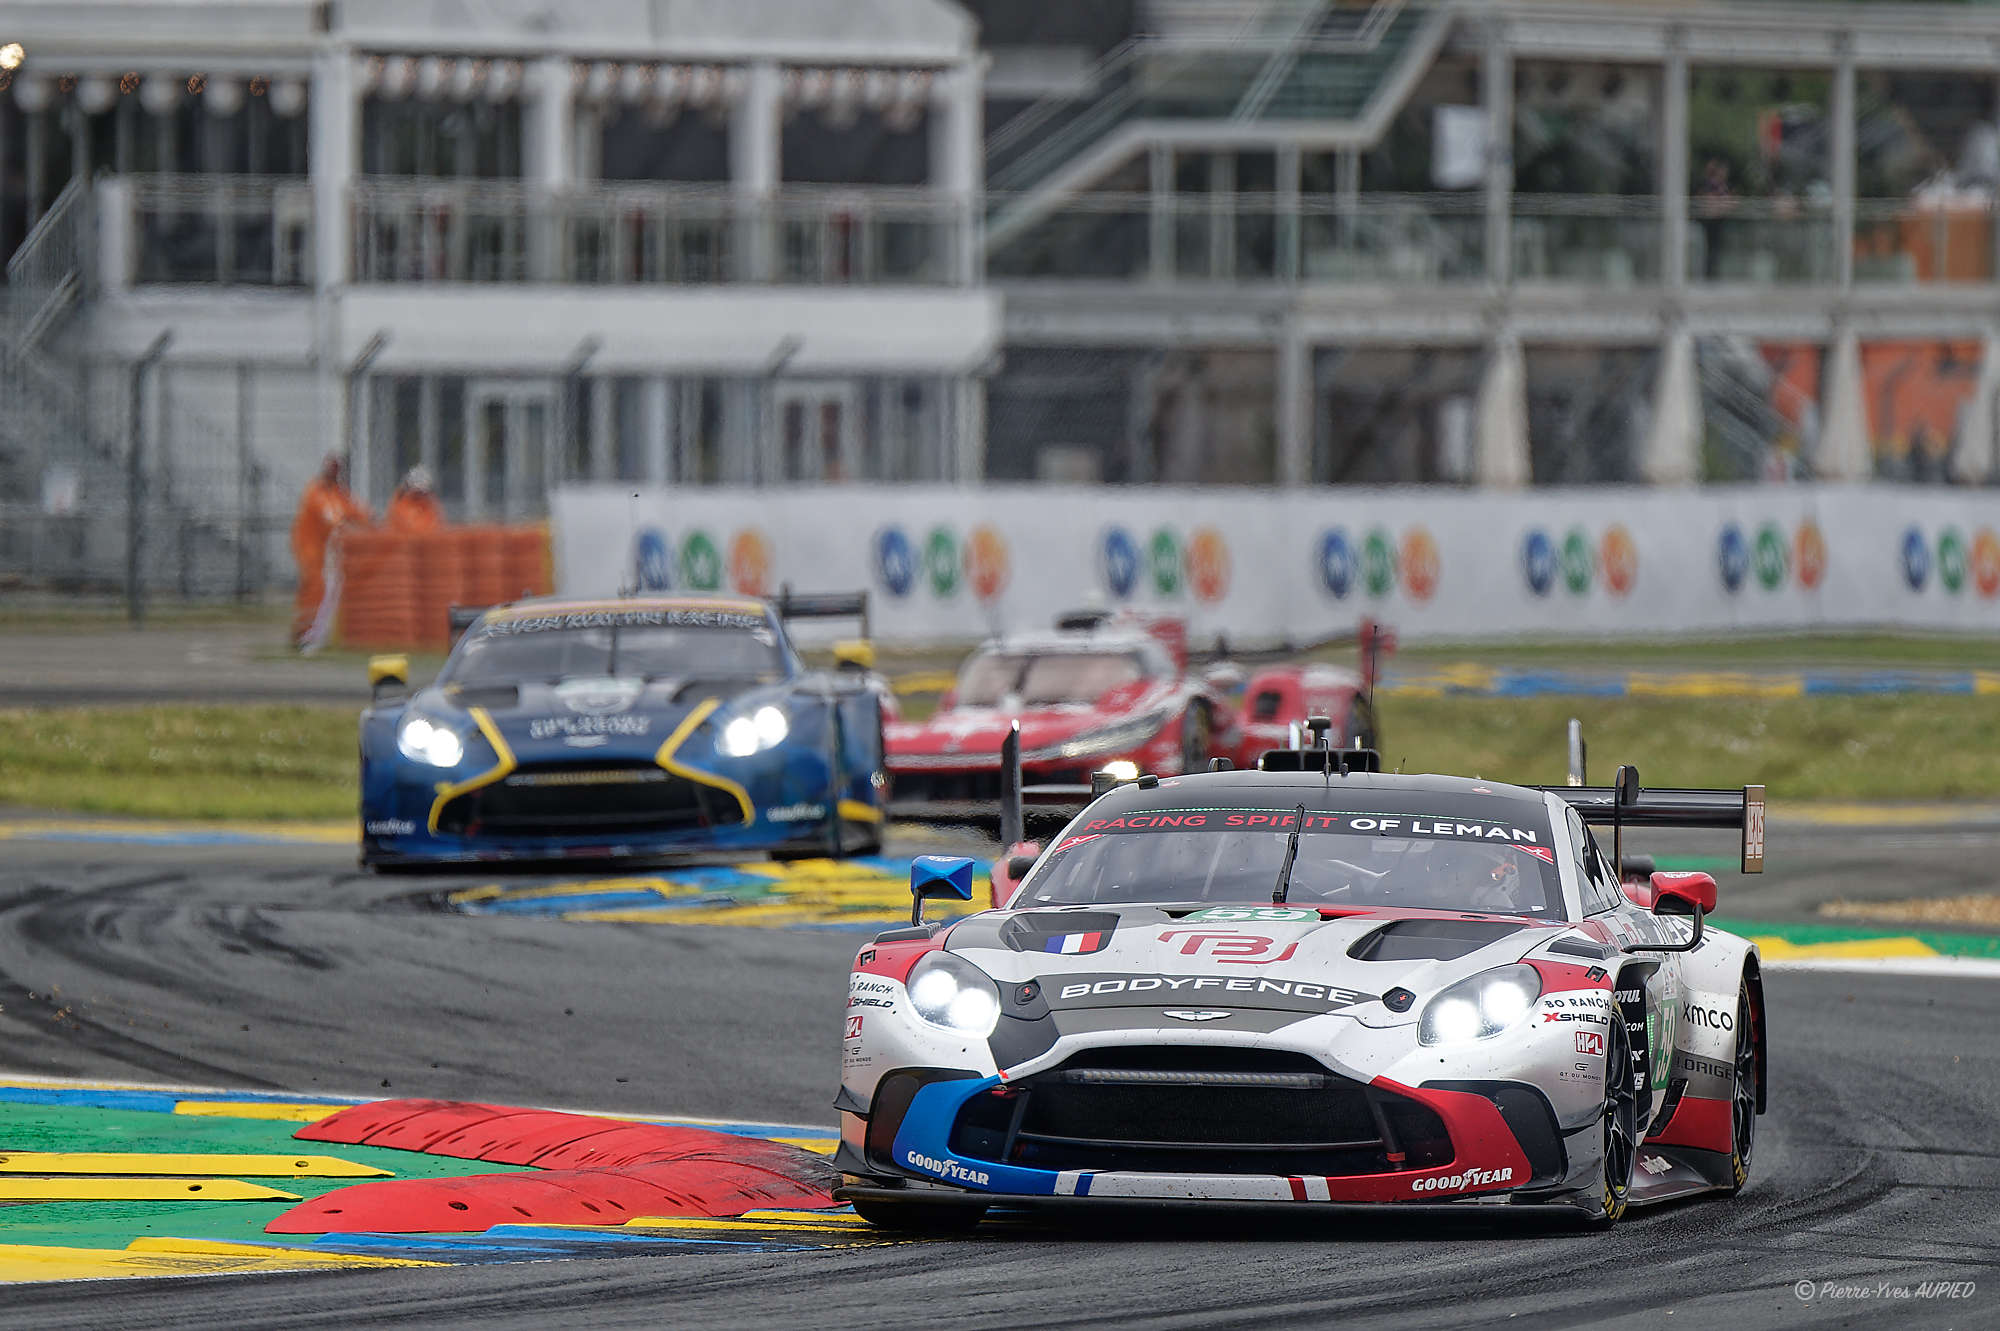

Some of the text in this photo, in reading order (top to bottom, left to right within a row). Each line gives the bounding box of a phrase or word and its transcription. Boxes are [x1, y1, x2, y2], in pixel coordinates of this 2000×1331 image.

[1084, 814, 1536, 843] RACING SPIRIT OF LEMAN
[1201, 905, 1307, 921] 59
[856, 982, 894, 994] RANCH
[1060, 977, 1359, 1006] BODYFENCE
[847, 996, 894, 1009] XSHIELD
[1614, 989, 1640, 1003] OTUL
[1568, 997, 1610, 1011] RANCH
[1543, 1012, 1609, 1026] XSHIELD
[908, 1151, 989, 1185] GOODYEAR
[1411, 1167, 1513, 1192] GOODYEAR
